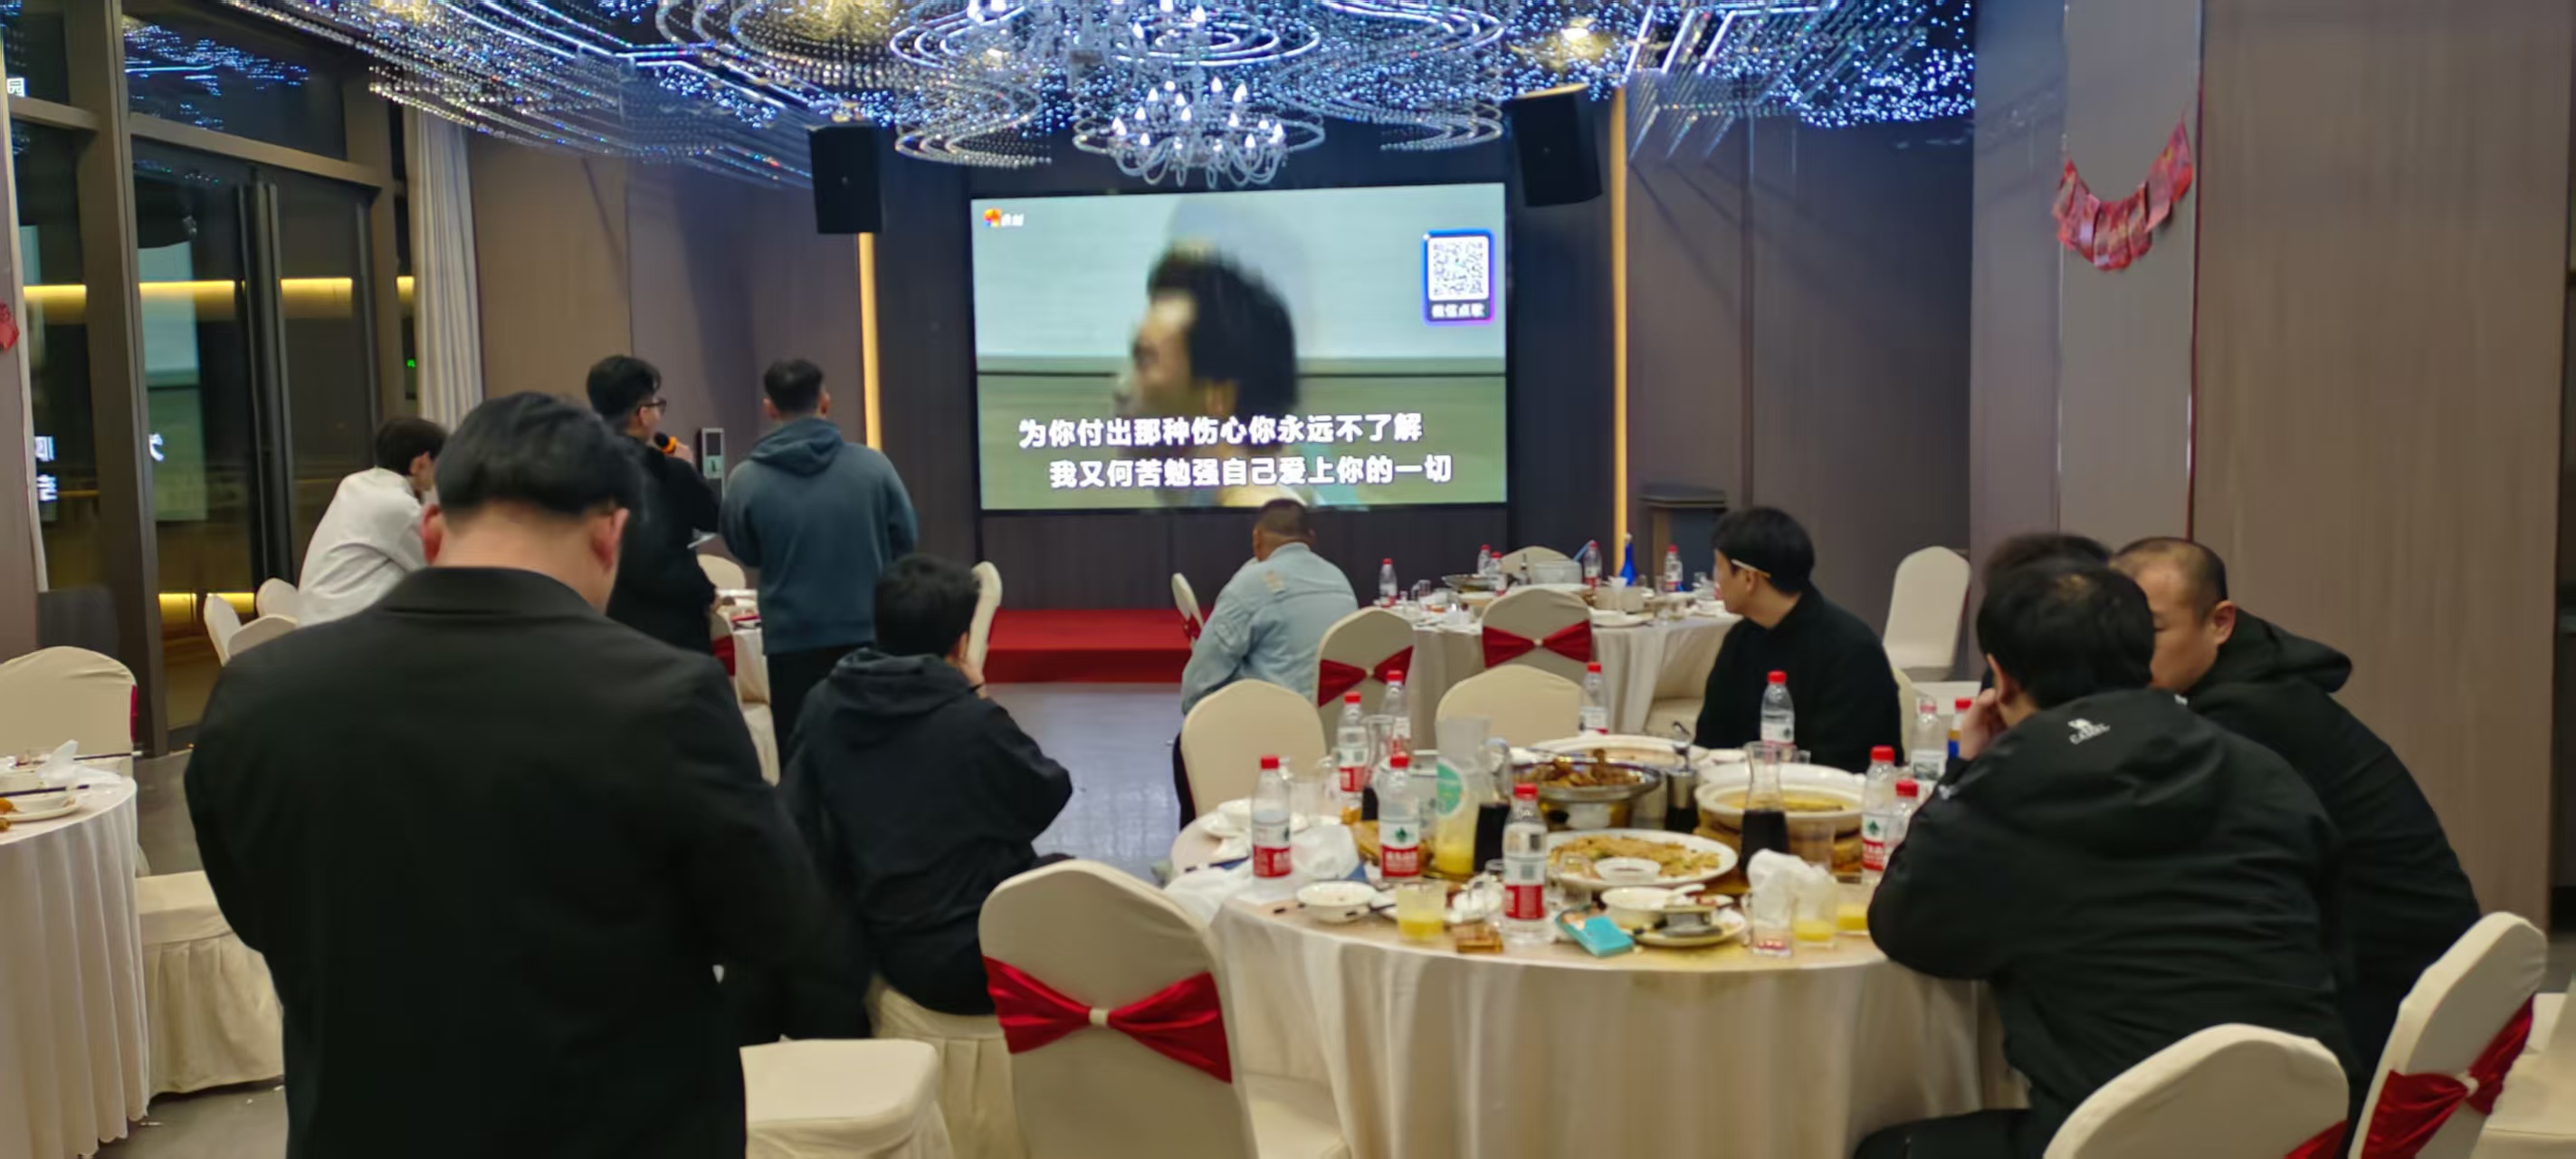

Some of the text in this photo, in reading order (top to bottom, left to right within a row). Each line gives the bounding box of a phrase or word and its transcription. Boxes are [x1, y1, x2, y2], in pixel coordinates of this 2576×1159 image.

[1019, 413, 1422, 448] 为你付出那种伤心你永远不了解
[1049, 455, 1452, 487] 我又何苦勉强自己爱上你的一切
